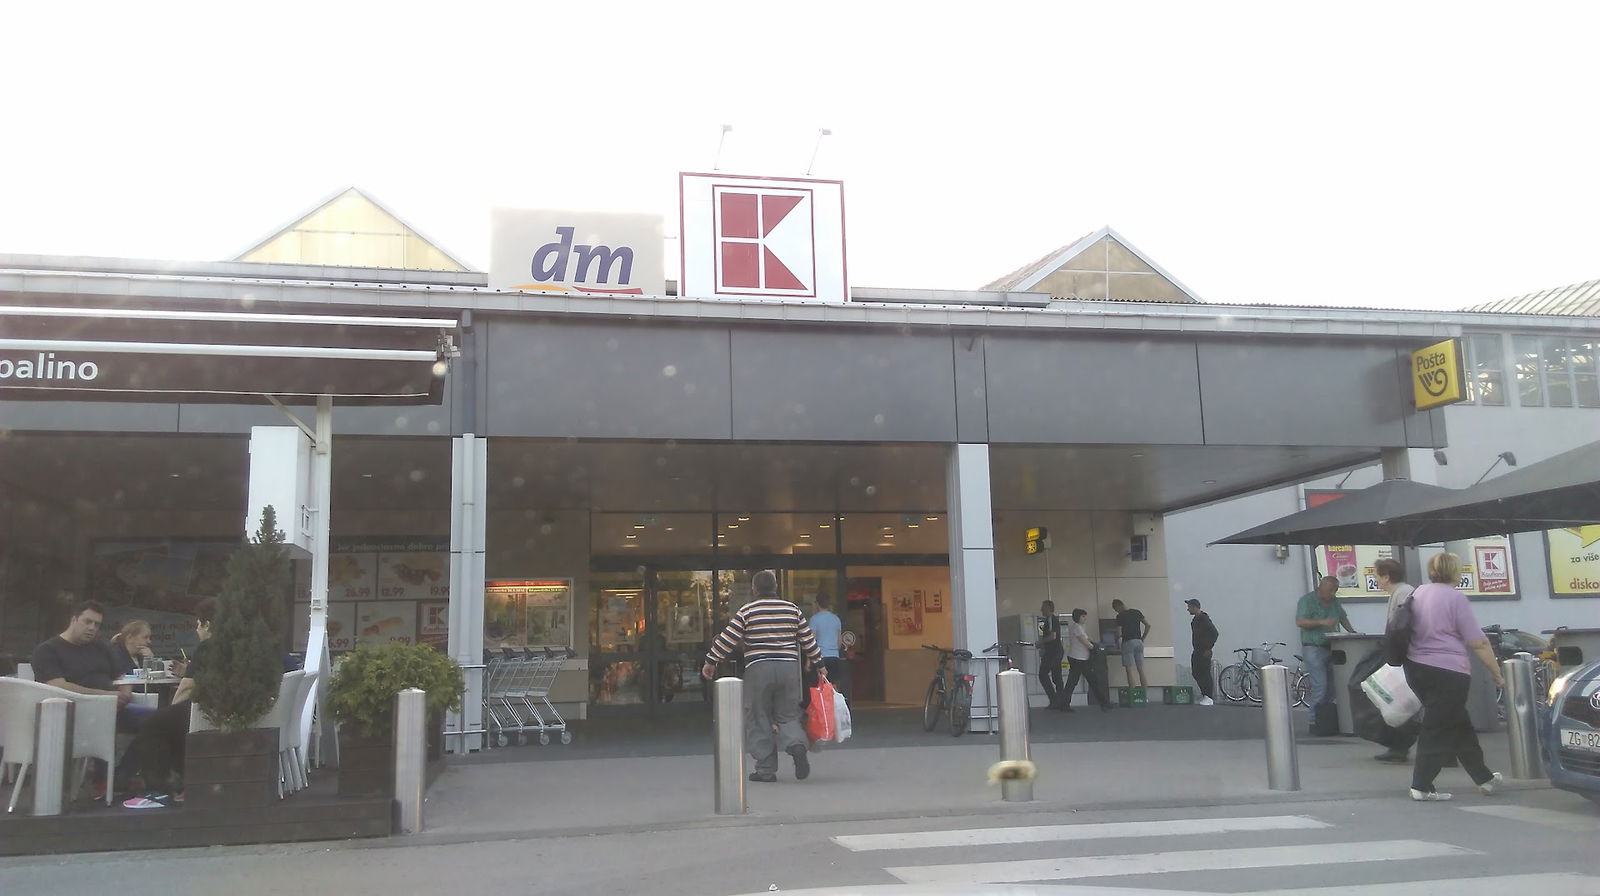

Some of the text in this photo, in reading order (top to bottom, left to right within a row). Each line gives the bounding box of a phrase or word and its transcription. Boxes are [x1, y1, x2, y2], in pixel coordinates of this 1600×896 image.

[531, 226, 635, 285] dm
[1416, 352, 1446, 372] Pošta
[1583, 552, 1600, 562] više
[430, 585, 449, 596] 19.9
[1568, 731, 1581, 746] ZG
